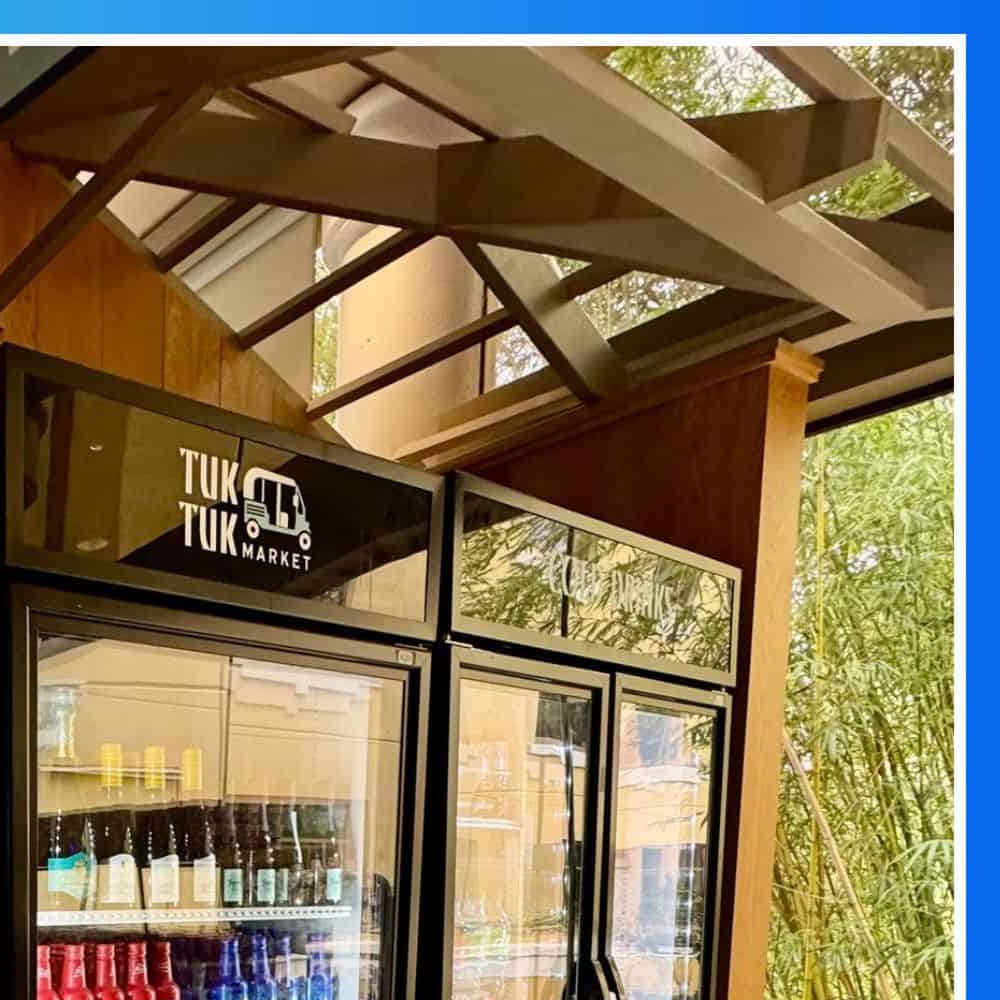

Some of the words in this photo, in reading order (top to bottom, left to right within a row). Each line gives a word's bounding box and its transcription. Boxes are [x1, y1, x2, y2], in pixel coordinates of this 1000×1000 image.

[178, 447, 239, 506] TUK
[178, 500, 239, 557] TUK
[241, 541, 312, 572] MARKET
